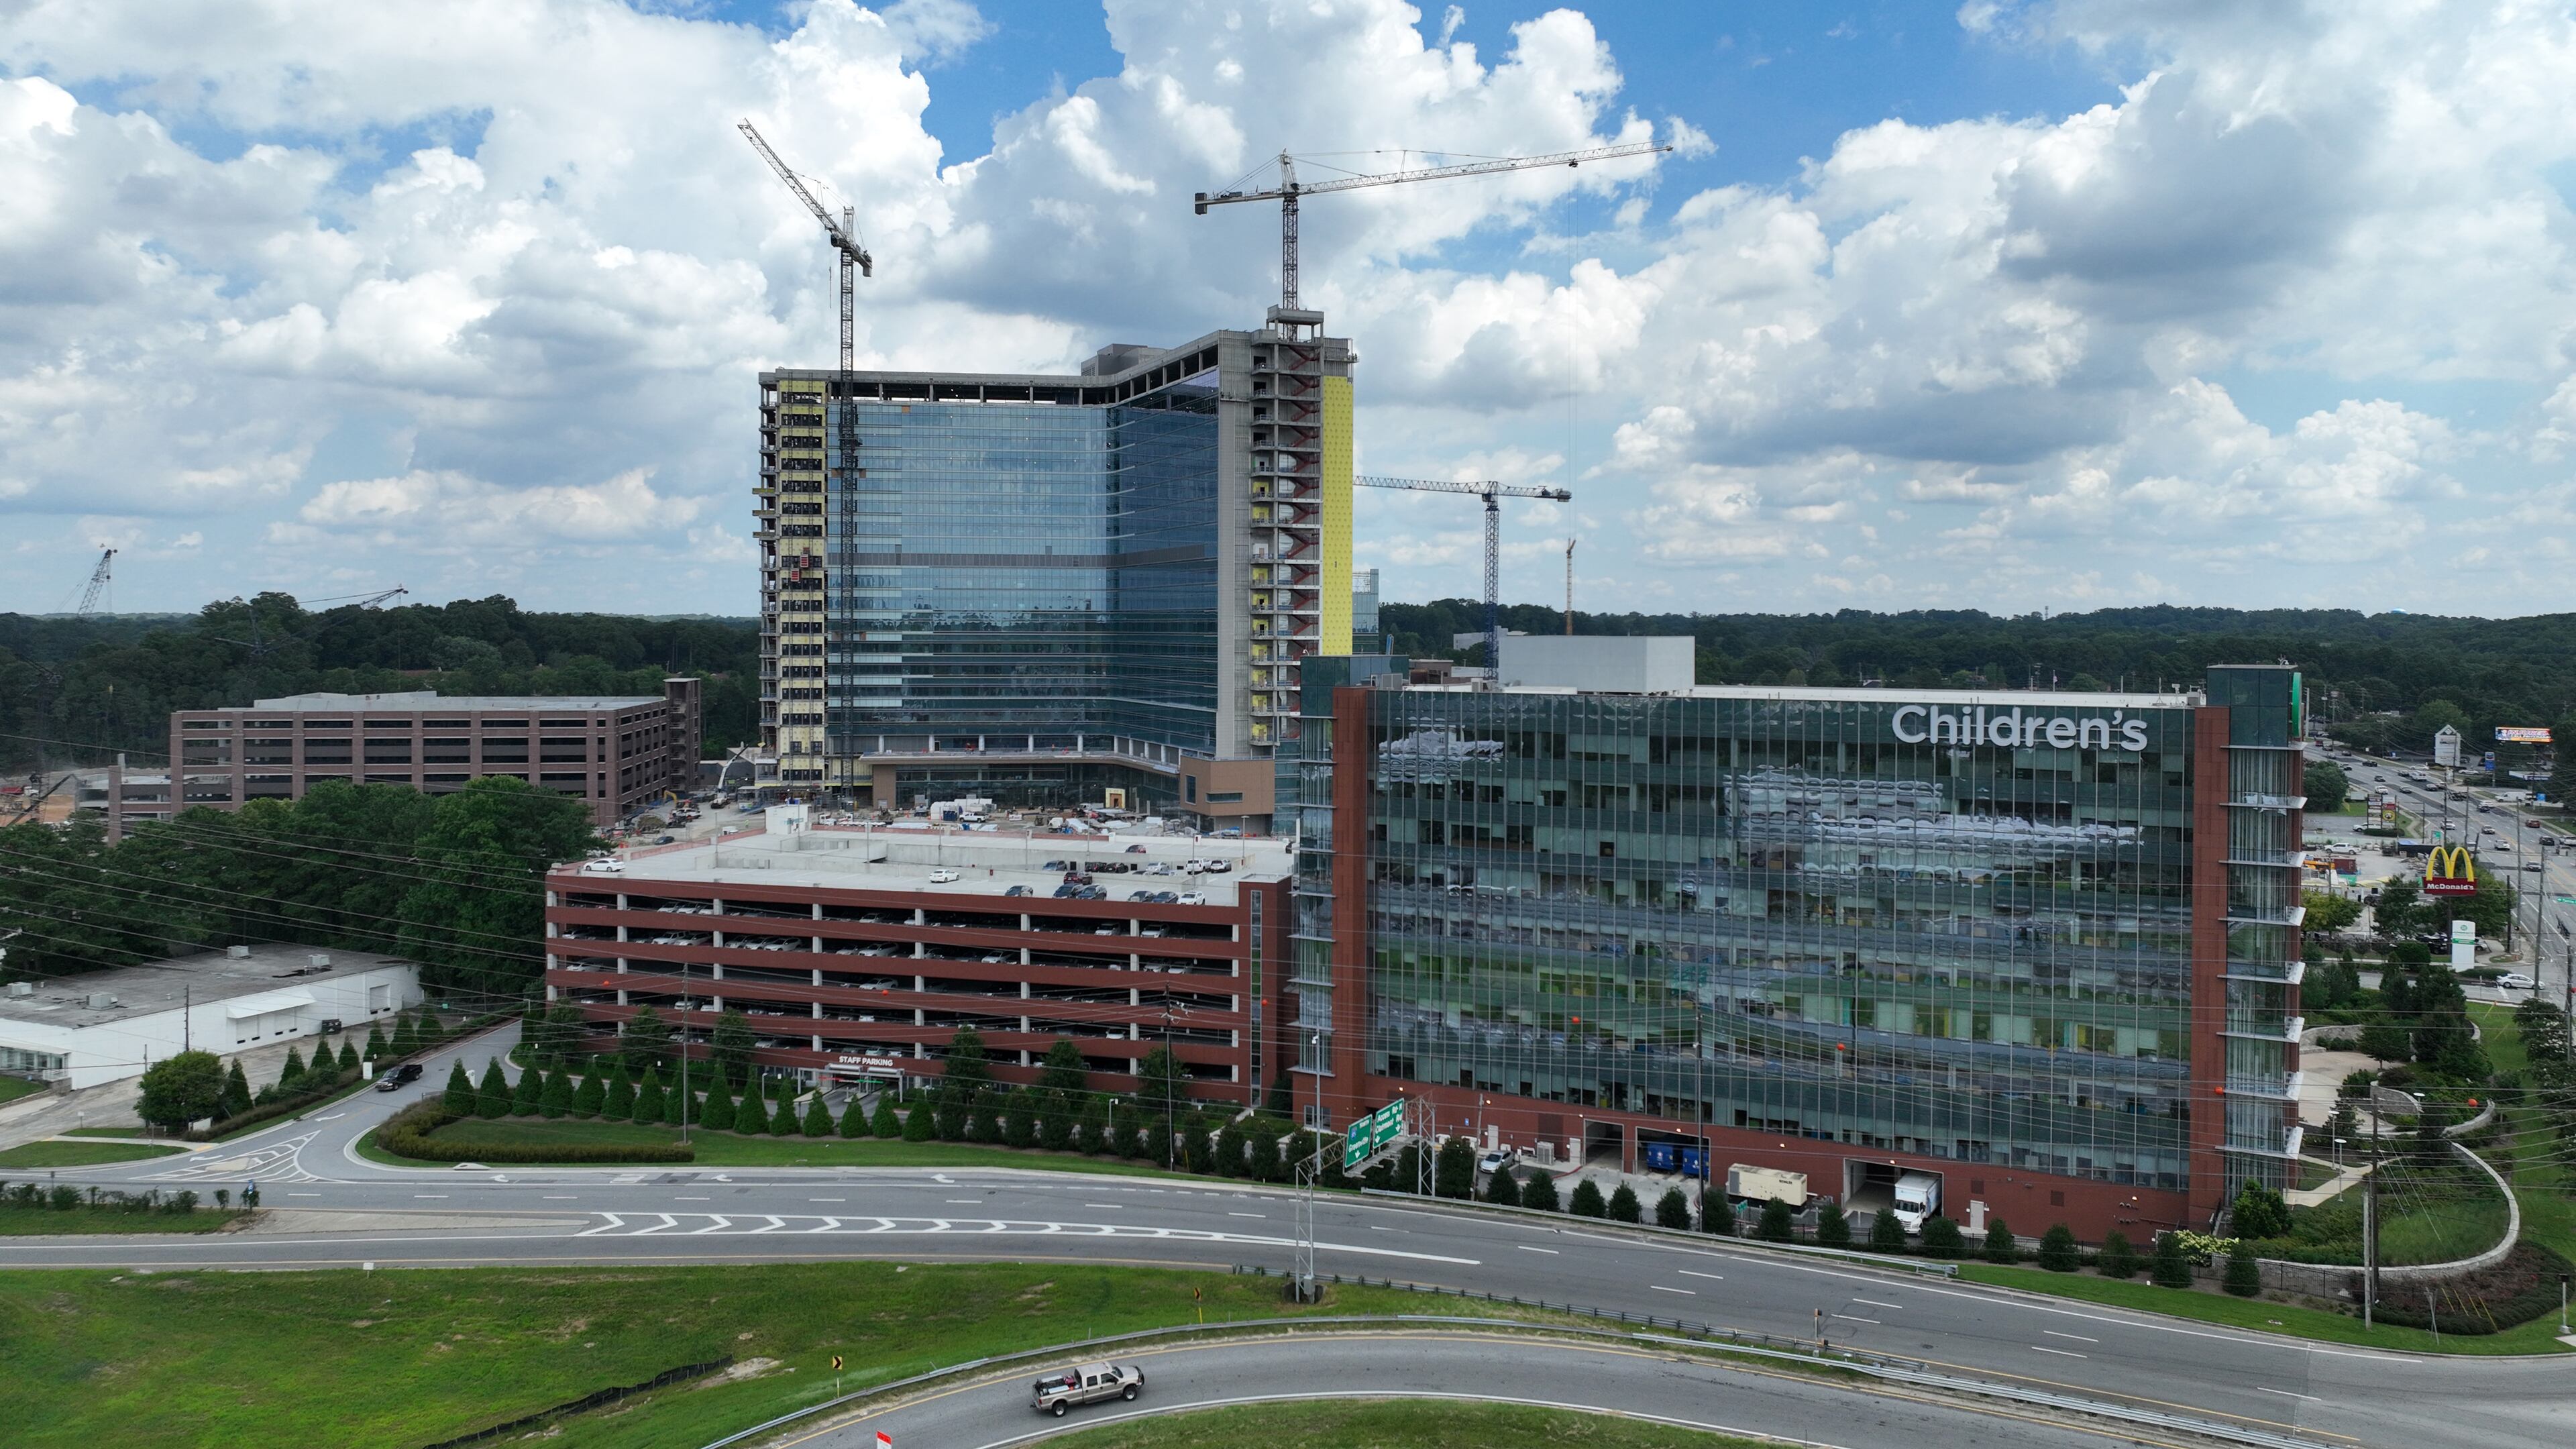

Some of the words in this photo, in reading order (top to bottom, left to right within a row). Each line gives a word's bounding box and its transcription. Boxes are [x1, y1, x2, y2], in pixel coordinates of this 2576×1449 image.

[1892, 704, 2148, 751] Children's
[862, 1058, 893, 1066] PARKING
[1348, 1136, 1368, 1152] Greenville
